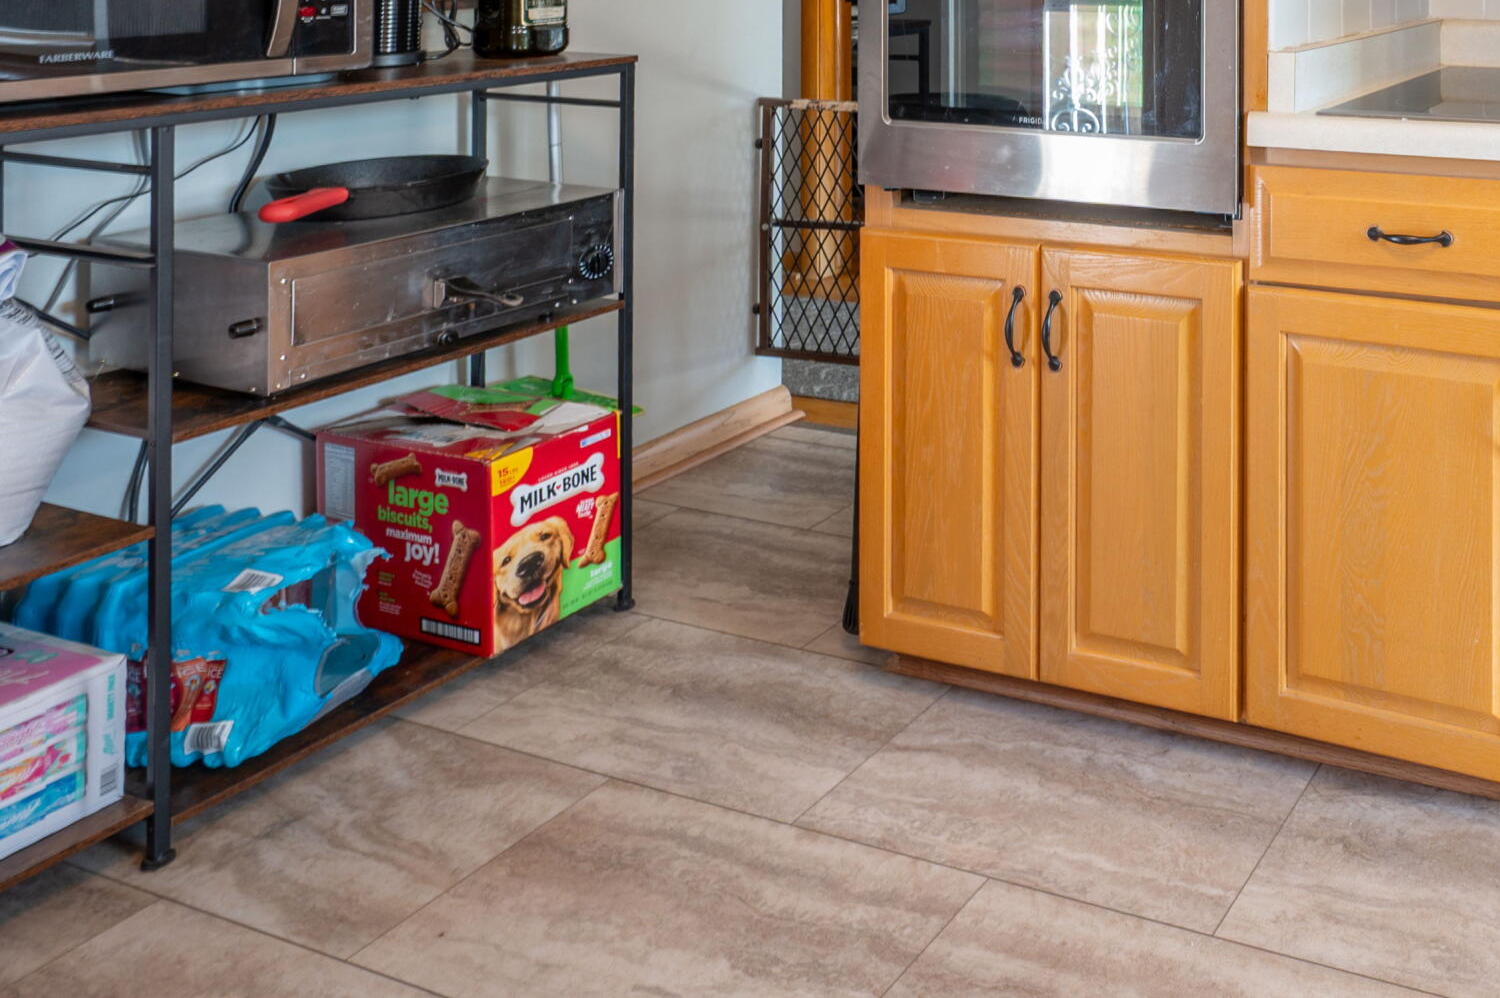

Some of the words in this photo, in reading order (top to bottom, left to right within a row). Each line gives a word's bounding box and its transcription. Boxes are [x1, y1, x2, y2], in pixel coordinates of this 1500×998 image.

[38, 50, 115, 64] FARBERWARE
[388, 479, 449, 517] large
[520, 481, 557, 514] MILK
[563, 464, 597, 492] BONE
[378, 504, 433, 533] biscuits,
[386, 527, 433, 545] maximum
